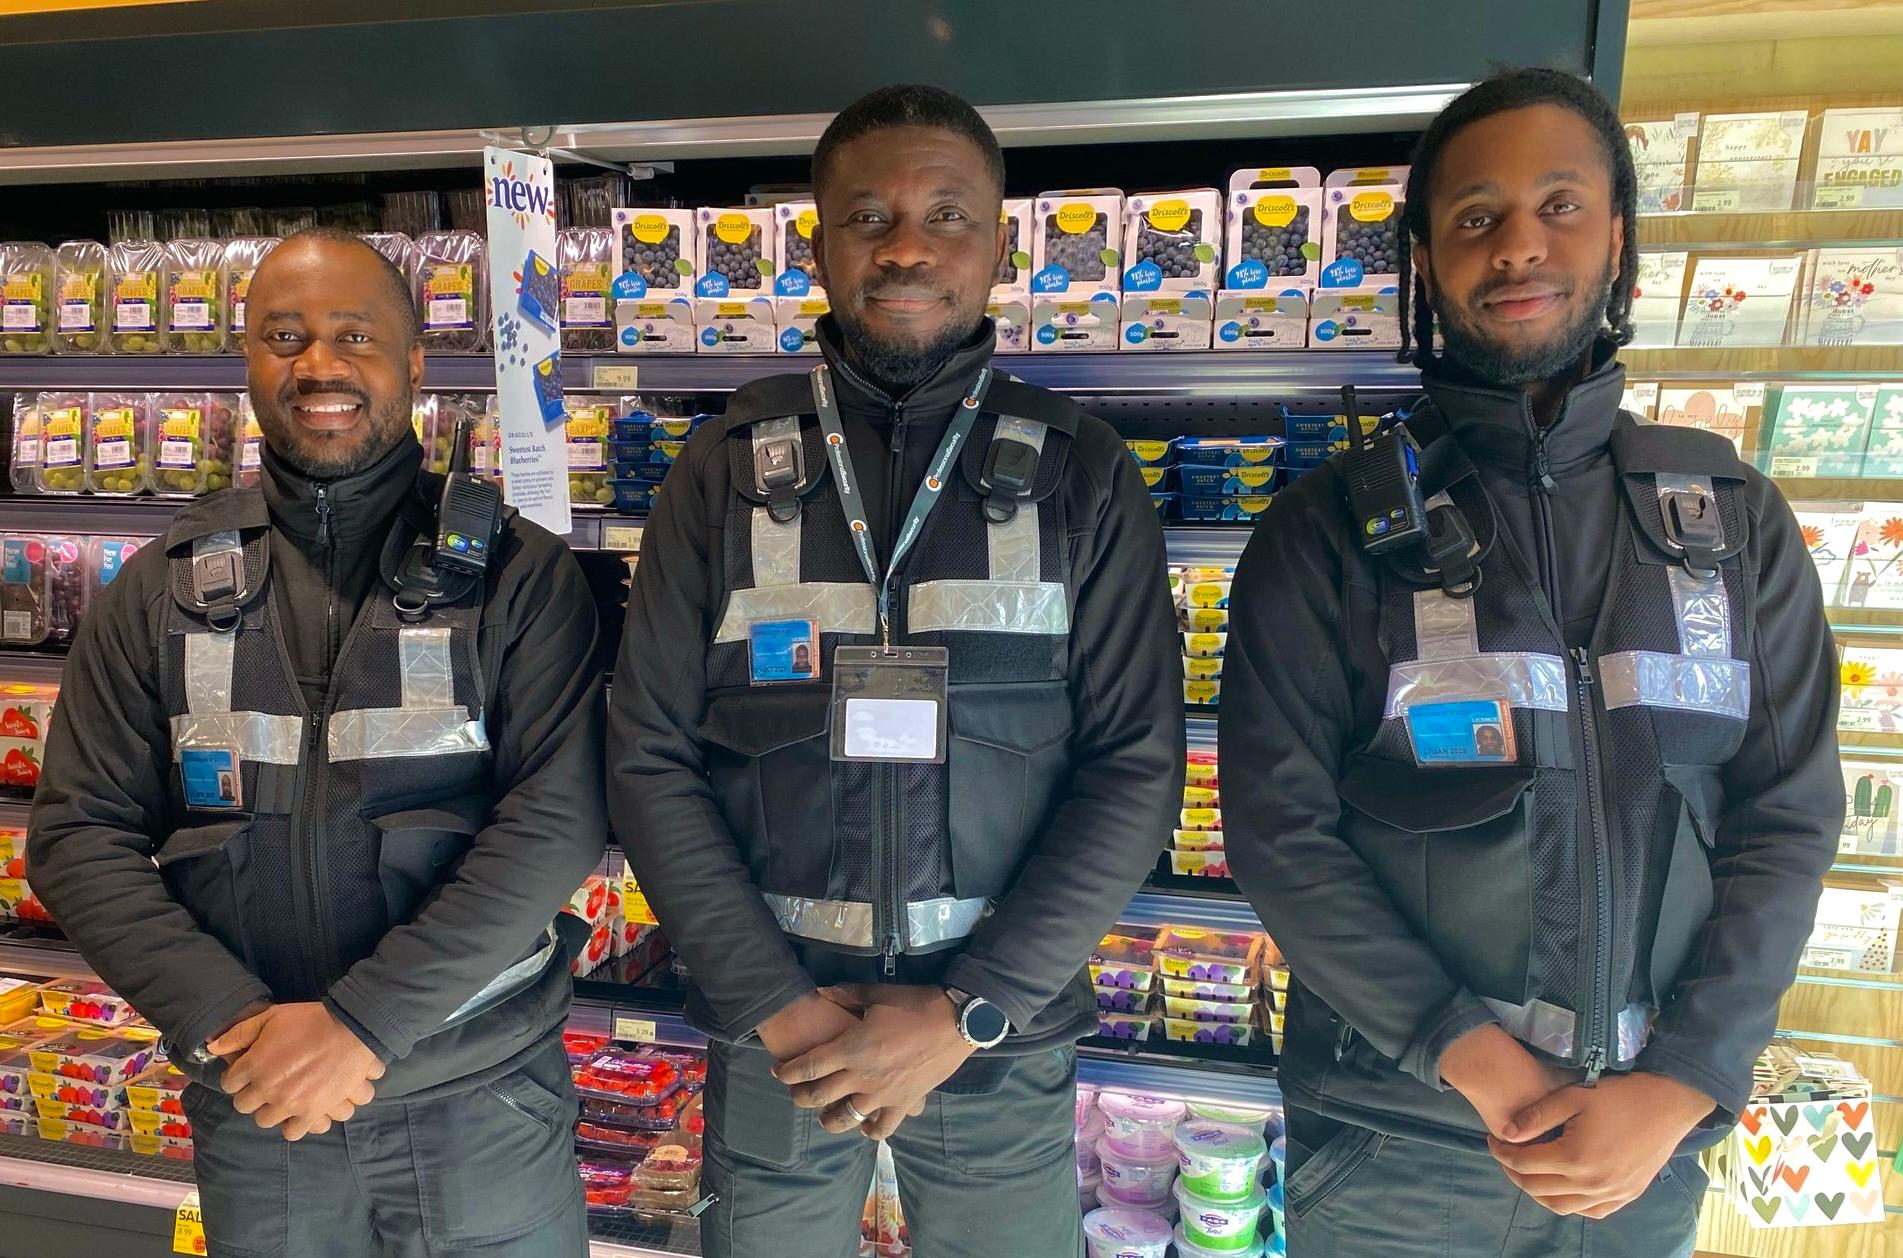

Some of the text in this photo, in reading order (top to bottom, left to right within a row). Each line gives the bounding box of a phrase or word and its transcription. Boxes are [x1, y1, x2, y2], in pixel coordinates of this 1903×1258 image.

[1846, 128, 1888, 153] YAY
[492, 177, 549, 215] new
[1152, 207, 1188, 217] Driscoll's
[1258, 203, 1295, 212] Driscoll's
[569, 278, 601, 290] GRAPES
[617, 375, 631, 383] 9.99
[568, 425, 600, 435] GRAPES
[509, 444, 546, 454] Sweetest Batch
[933, 432, 961, 481] ProfessionalSecurity
[103, 548, 117, 557] New
[179, 1209, 203, 1223] SAL
